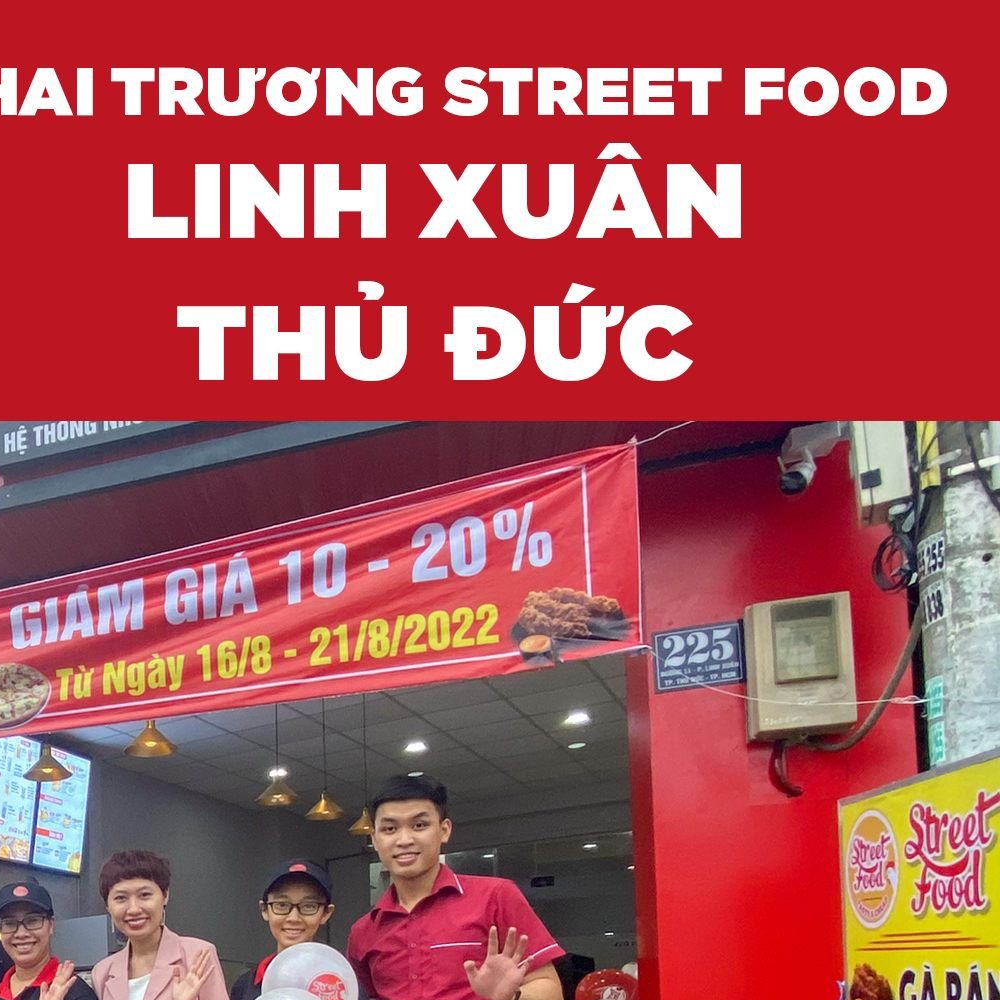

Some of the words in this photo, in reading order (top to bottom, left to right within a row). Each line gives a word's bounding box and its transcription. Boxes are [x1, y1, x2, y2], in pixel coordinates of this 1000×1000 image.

[3, 424, 28, 455] HỆ
[9, 577, 145, 650] GIẢM
[164, 551, 259, 626] GIÁ
[279, 542, 347, 606] 10
[367, 558, 390, 573] -
[411, 501, 553, 584] 20%
[55, 664, 95, 702] Từ
[102, 653, 185, 697] Ngày
[196, 634, 273, 682] 16/8
[308, 603, 500, 667] 21/8/2022
[662, 627, 735, 668] 225
[852, 835, 890, 866] Street
[904, 792, 1000, 862] Street
[911, 850, 984, 912] Food
